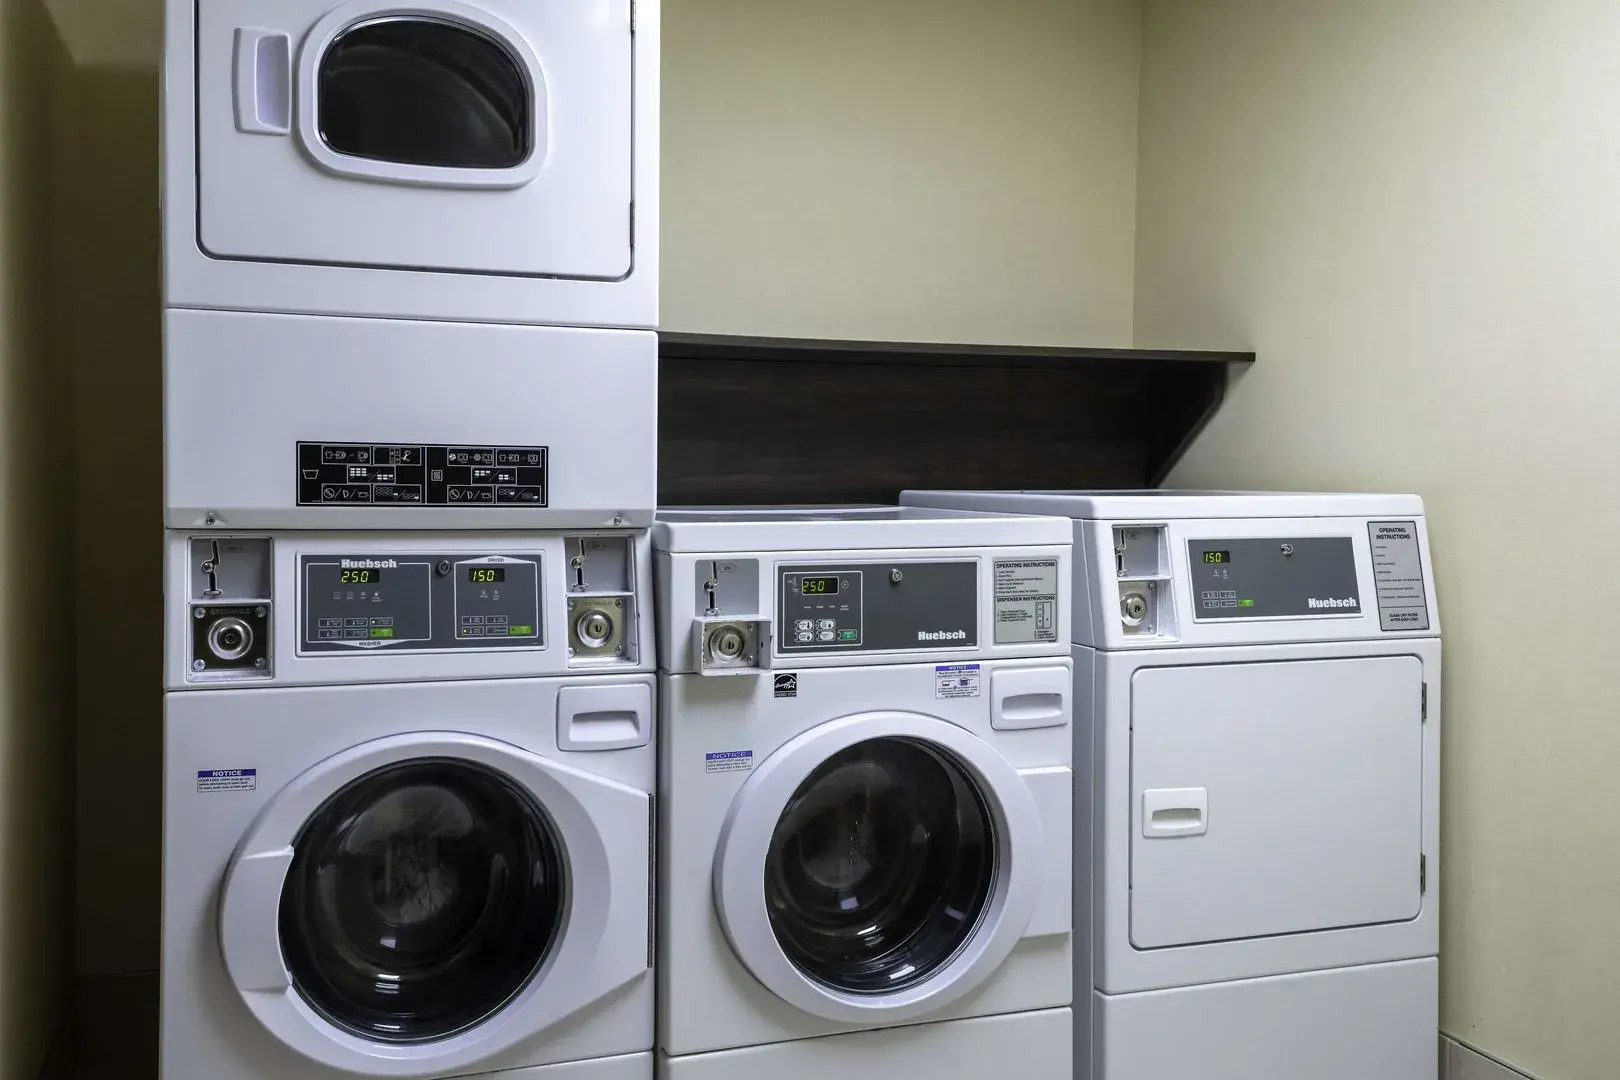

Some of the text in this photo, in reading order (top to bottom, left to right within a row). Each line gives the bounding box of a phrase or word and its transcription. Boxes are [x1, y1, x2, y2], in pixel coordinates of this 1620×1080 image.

[1205, 552, 1222, 562] 150
[341, 559, 397, 568] Huebsch
[341, 571, 369, 583] 250
[473, 570, 495, 582] 150
[803, 580, 825, 592] 250
[1308, 597, 1357, 608] Huebsch
[918, 630, 966, 640] Huebsch
